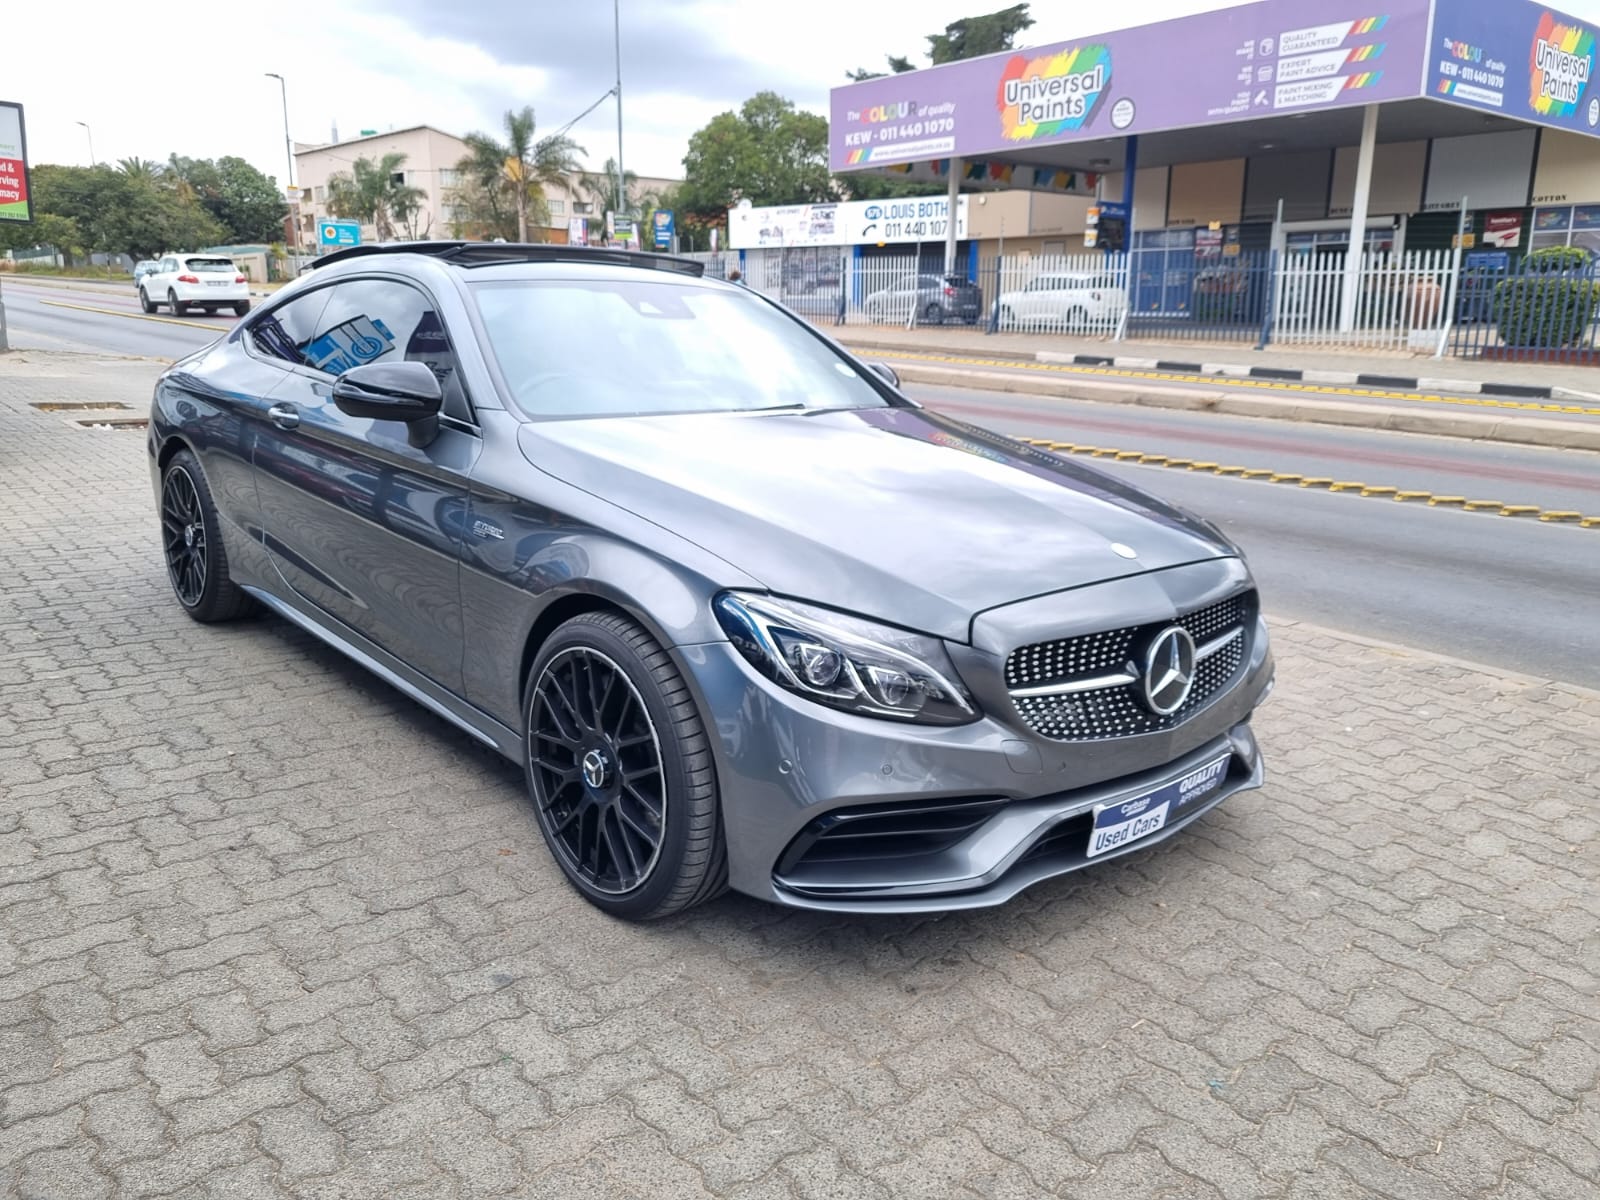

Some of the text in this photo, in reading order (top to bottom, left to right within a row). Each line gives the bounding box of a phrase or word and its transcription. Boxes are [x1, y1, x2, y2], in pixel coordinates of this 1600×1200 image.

[1282, 31, 1318, 44] QUALITY
[1282, 36, 1338, 52] GUARANTEED
[1537, 40, 1589, 80] Universal
[1280, 63, 1336, 79] PAINT ADVICE
[1440, 60, 1459, 77] KEW
[1462, 66, 1474, 81] 011
[1474, 69, 1487, 85] 440
[1487, 72, 1504, 89] 1070
[1006, 67, 1101, 103] Universal
[1541, 69, 1578, 102] Paints
[1284, 91, 1328, 103] MATCHING
[846, 110, 860, 122] The
[861, 101, 917, 125] COLOUR
[918, 105, 928, 117] of
[1020, 95, 1084, 123] Paints
[844, 130, 872, 147] KEW
[879, 126, 898, 142] 011
[898, 121, 923, 139] 440
[924, 117, 955, 135] 1070
[8, 162, 15, 173] &
[0, 175, 19, 189] rving
[0, 190, 20, 201] macy
[883, 203, 915, 220] LOUIS
[918, 201, 948, 218] BOTH
[885, 222, 901, 238] 011
[904, 221, 926, 236] 440
[1179, 760, 1225, 794] QUALITY
[1095, 814, 1161, 851] Used Cars
